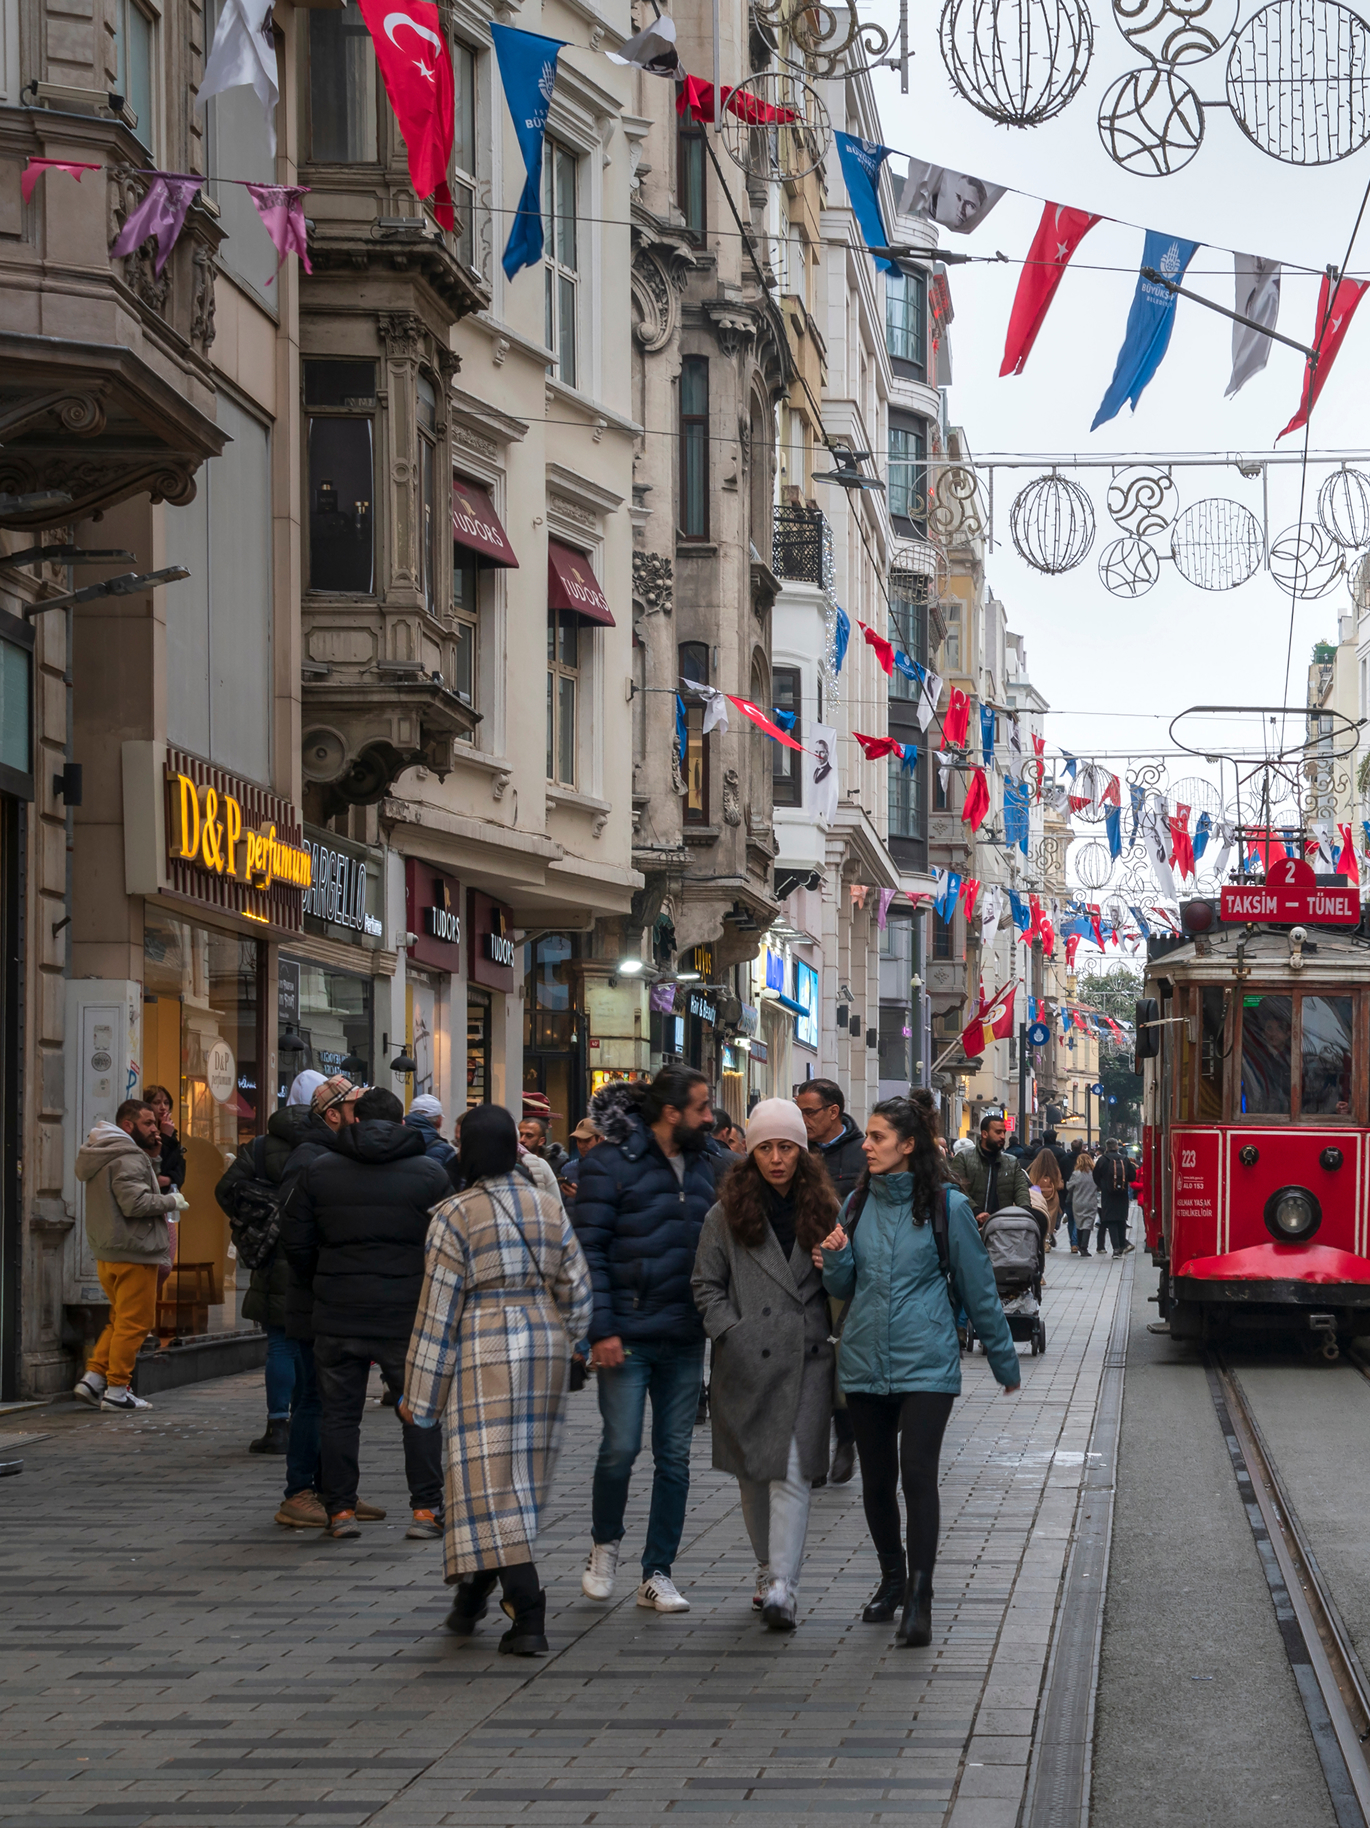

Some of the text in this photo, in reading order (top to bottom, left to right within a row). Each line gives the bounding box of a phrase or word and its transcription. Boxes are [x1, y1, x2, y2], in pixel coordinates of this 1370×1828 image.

[560, 575, 609, 612] TUDORS
[177, 773, 312, 891] D&P perfumum
[1285, 861, 1296, 884] 2
[1226, 891, 1278, 914] TAKSİM
[1307, 892, 1353, 916] TÜNEL
[432, 905, 461, 945] TUDORS
[490, 932, 515, 968] TUDORS
[214, 1051, 230, 1072] D&P
[1182, 1150, 1196, 1168] 223
